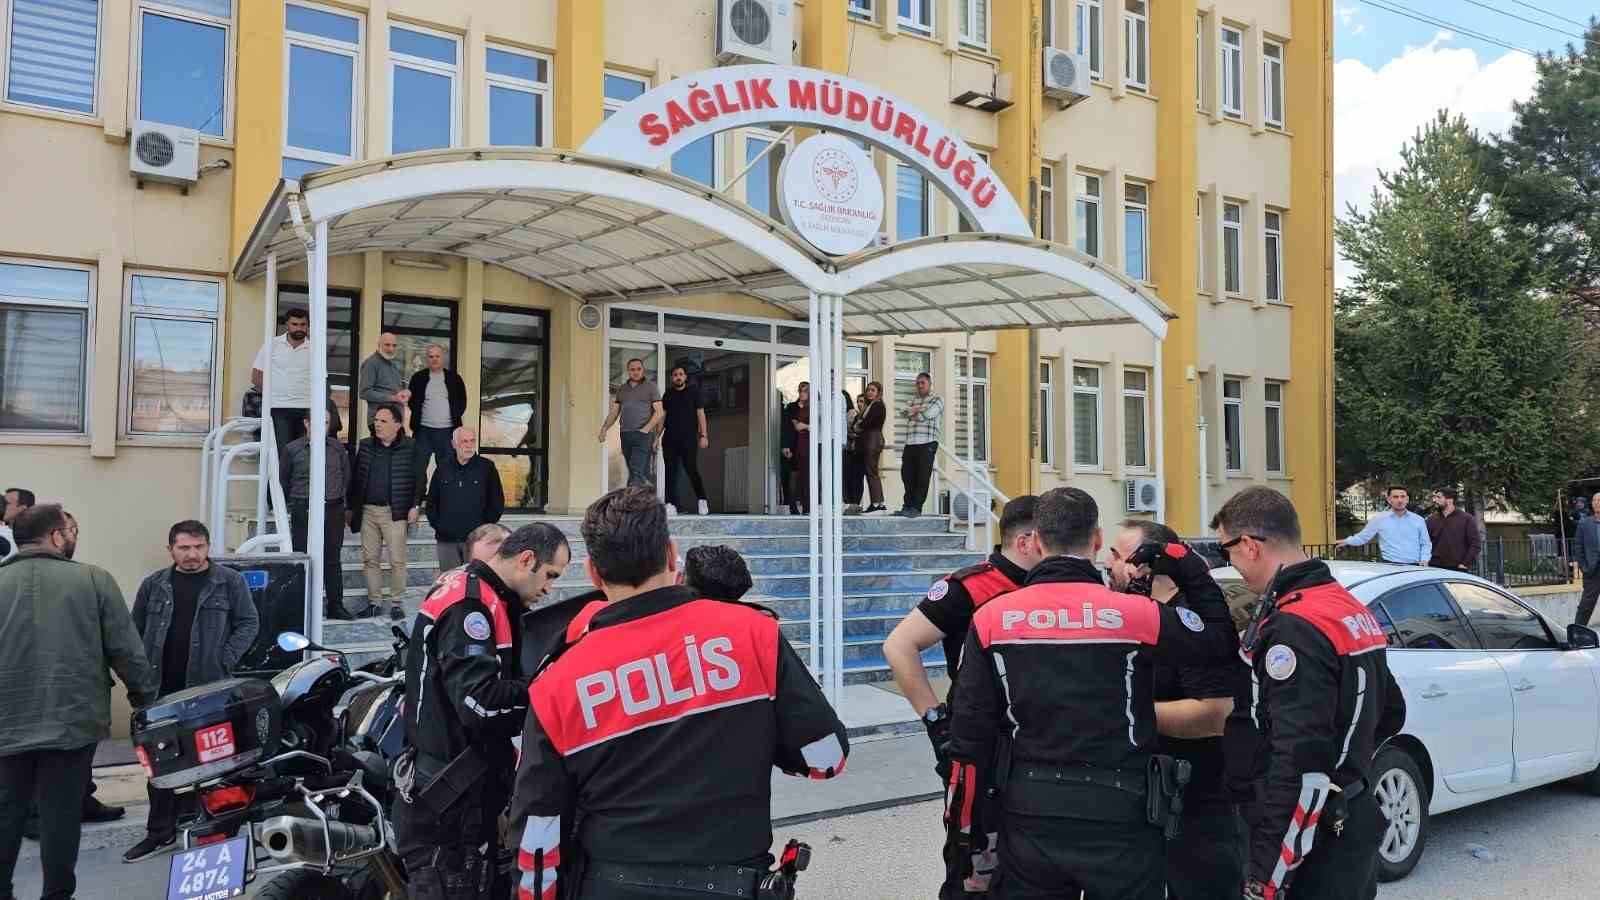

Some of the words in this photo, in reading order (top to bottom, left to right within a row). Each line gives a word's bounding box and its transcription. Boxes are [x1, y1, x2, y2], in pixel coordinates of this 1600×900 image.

[639, 78, 779, 146] SAĞLIK
[788, 79, 997, 209] MÜDÜRLÜĞÜ
[1002, 602, 1124, 630] POLİS
[576, 635, 741, 730] POLİS
[201, 727, 229, 749] 112
[182, 849, 207, 873] 24
[216, 844, 232, 865] A
[179, 866, 230, 895] 4874
